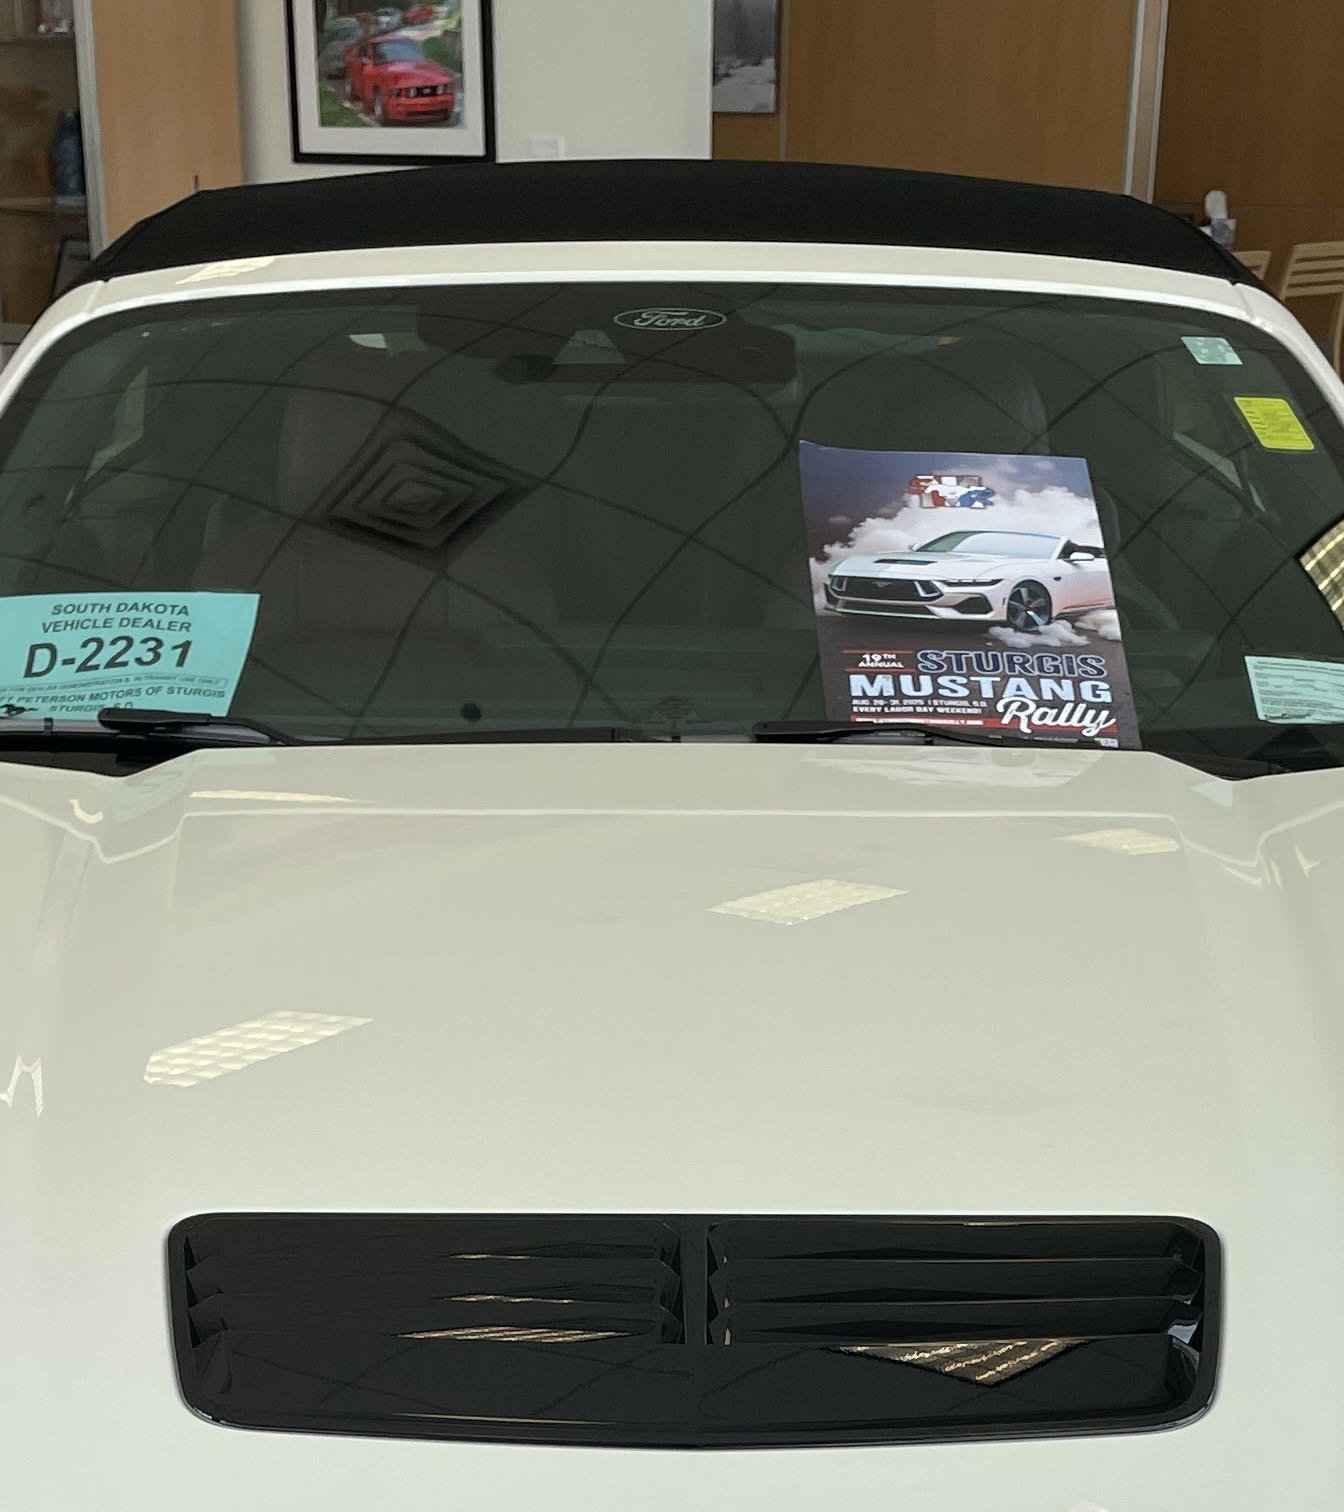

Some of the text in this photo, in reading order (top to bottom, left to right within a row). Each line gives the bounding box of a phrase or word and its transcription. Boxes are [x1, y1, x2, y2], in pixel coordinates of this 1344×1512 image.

[634, 311, 707, 326] Ford
[51, 602, 190, 616] SOUTH DAKOTA
[42, 617, 193, 634] VEHICLE DEALER
[23, 635, 193, 679] D-2231
[917, 649, 1107, 679] STURGIS
[16, 693, 86, 704] PETERSON
[89, 687, 142, 701] MOTORS
[145, 686, 163, 697] OF
[166, 686, 225, 698] STURGIS
[849, 674, 1113, 703] MUSTANG
[996, 697, 1116, 737] Rally
